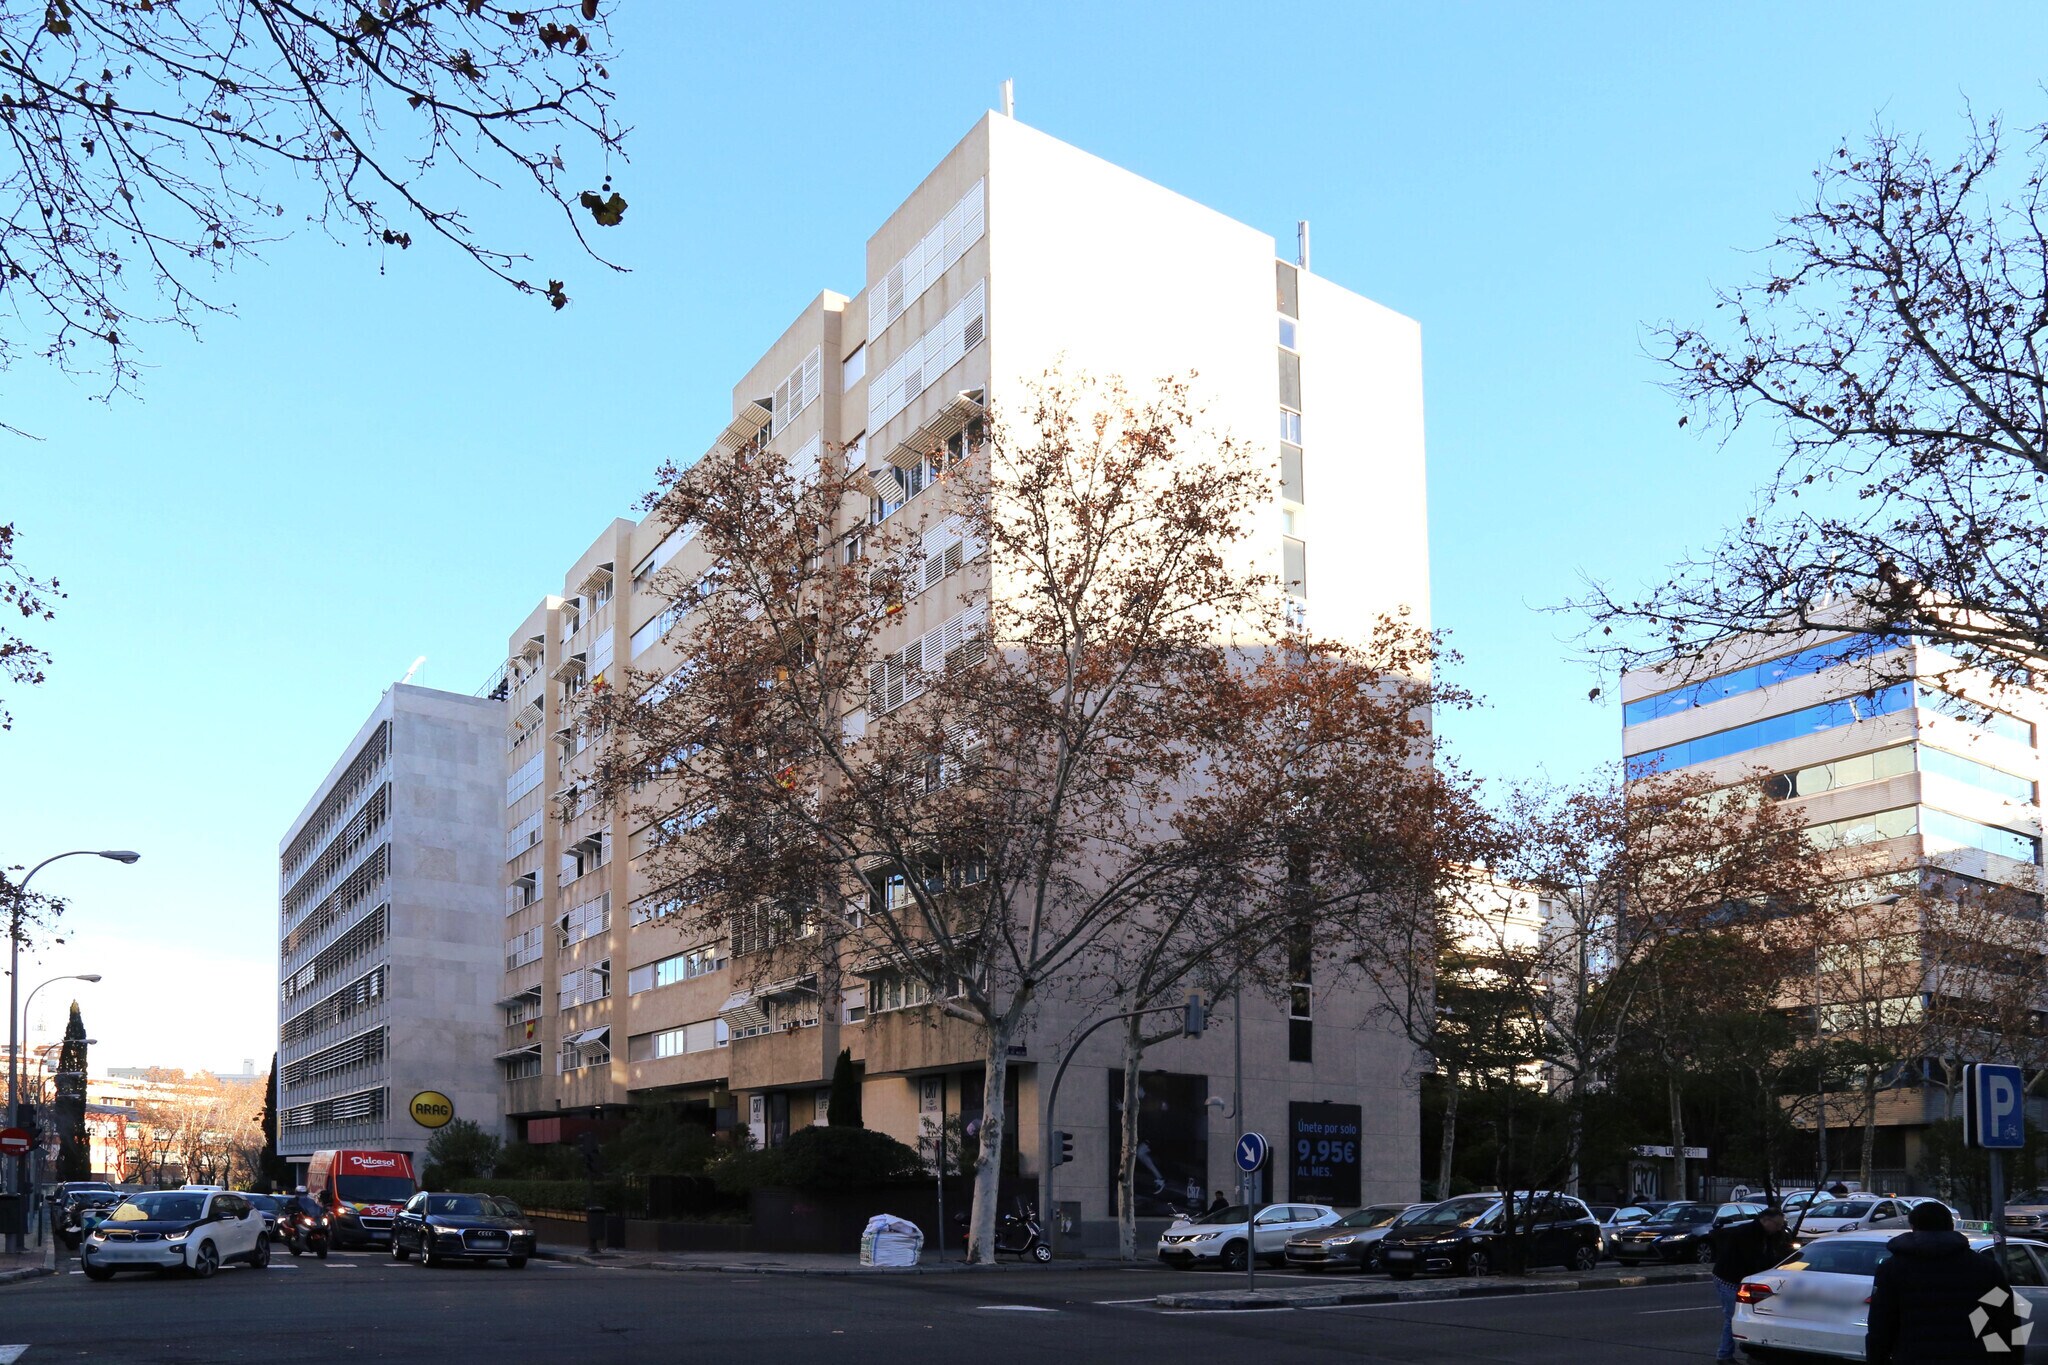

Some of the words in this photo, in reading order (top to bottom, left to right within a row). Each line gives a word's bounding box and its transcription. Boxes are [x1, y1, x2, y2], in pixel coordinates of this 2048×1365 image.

[415, 1103, 448, 1115] ARAG
[1989, 1075, 2014, 1137] P
[1298, 1119, 1322, 1133] Únete
[1325, 1124, 1338, 1136] por
[1341, 1123, 1357, 1135] solo
[1297, 1139, 1355, 1164] 9,95€
[351, 1156, 396, 1168] Dulcesol
[1297, 1166, 1309, 1177] AL
[1311, 1166, 1333, 1177] MES.
[1187, 1186, 1201, 1199] CR7
